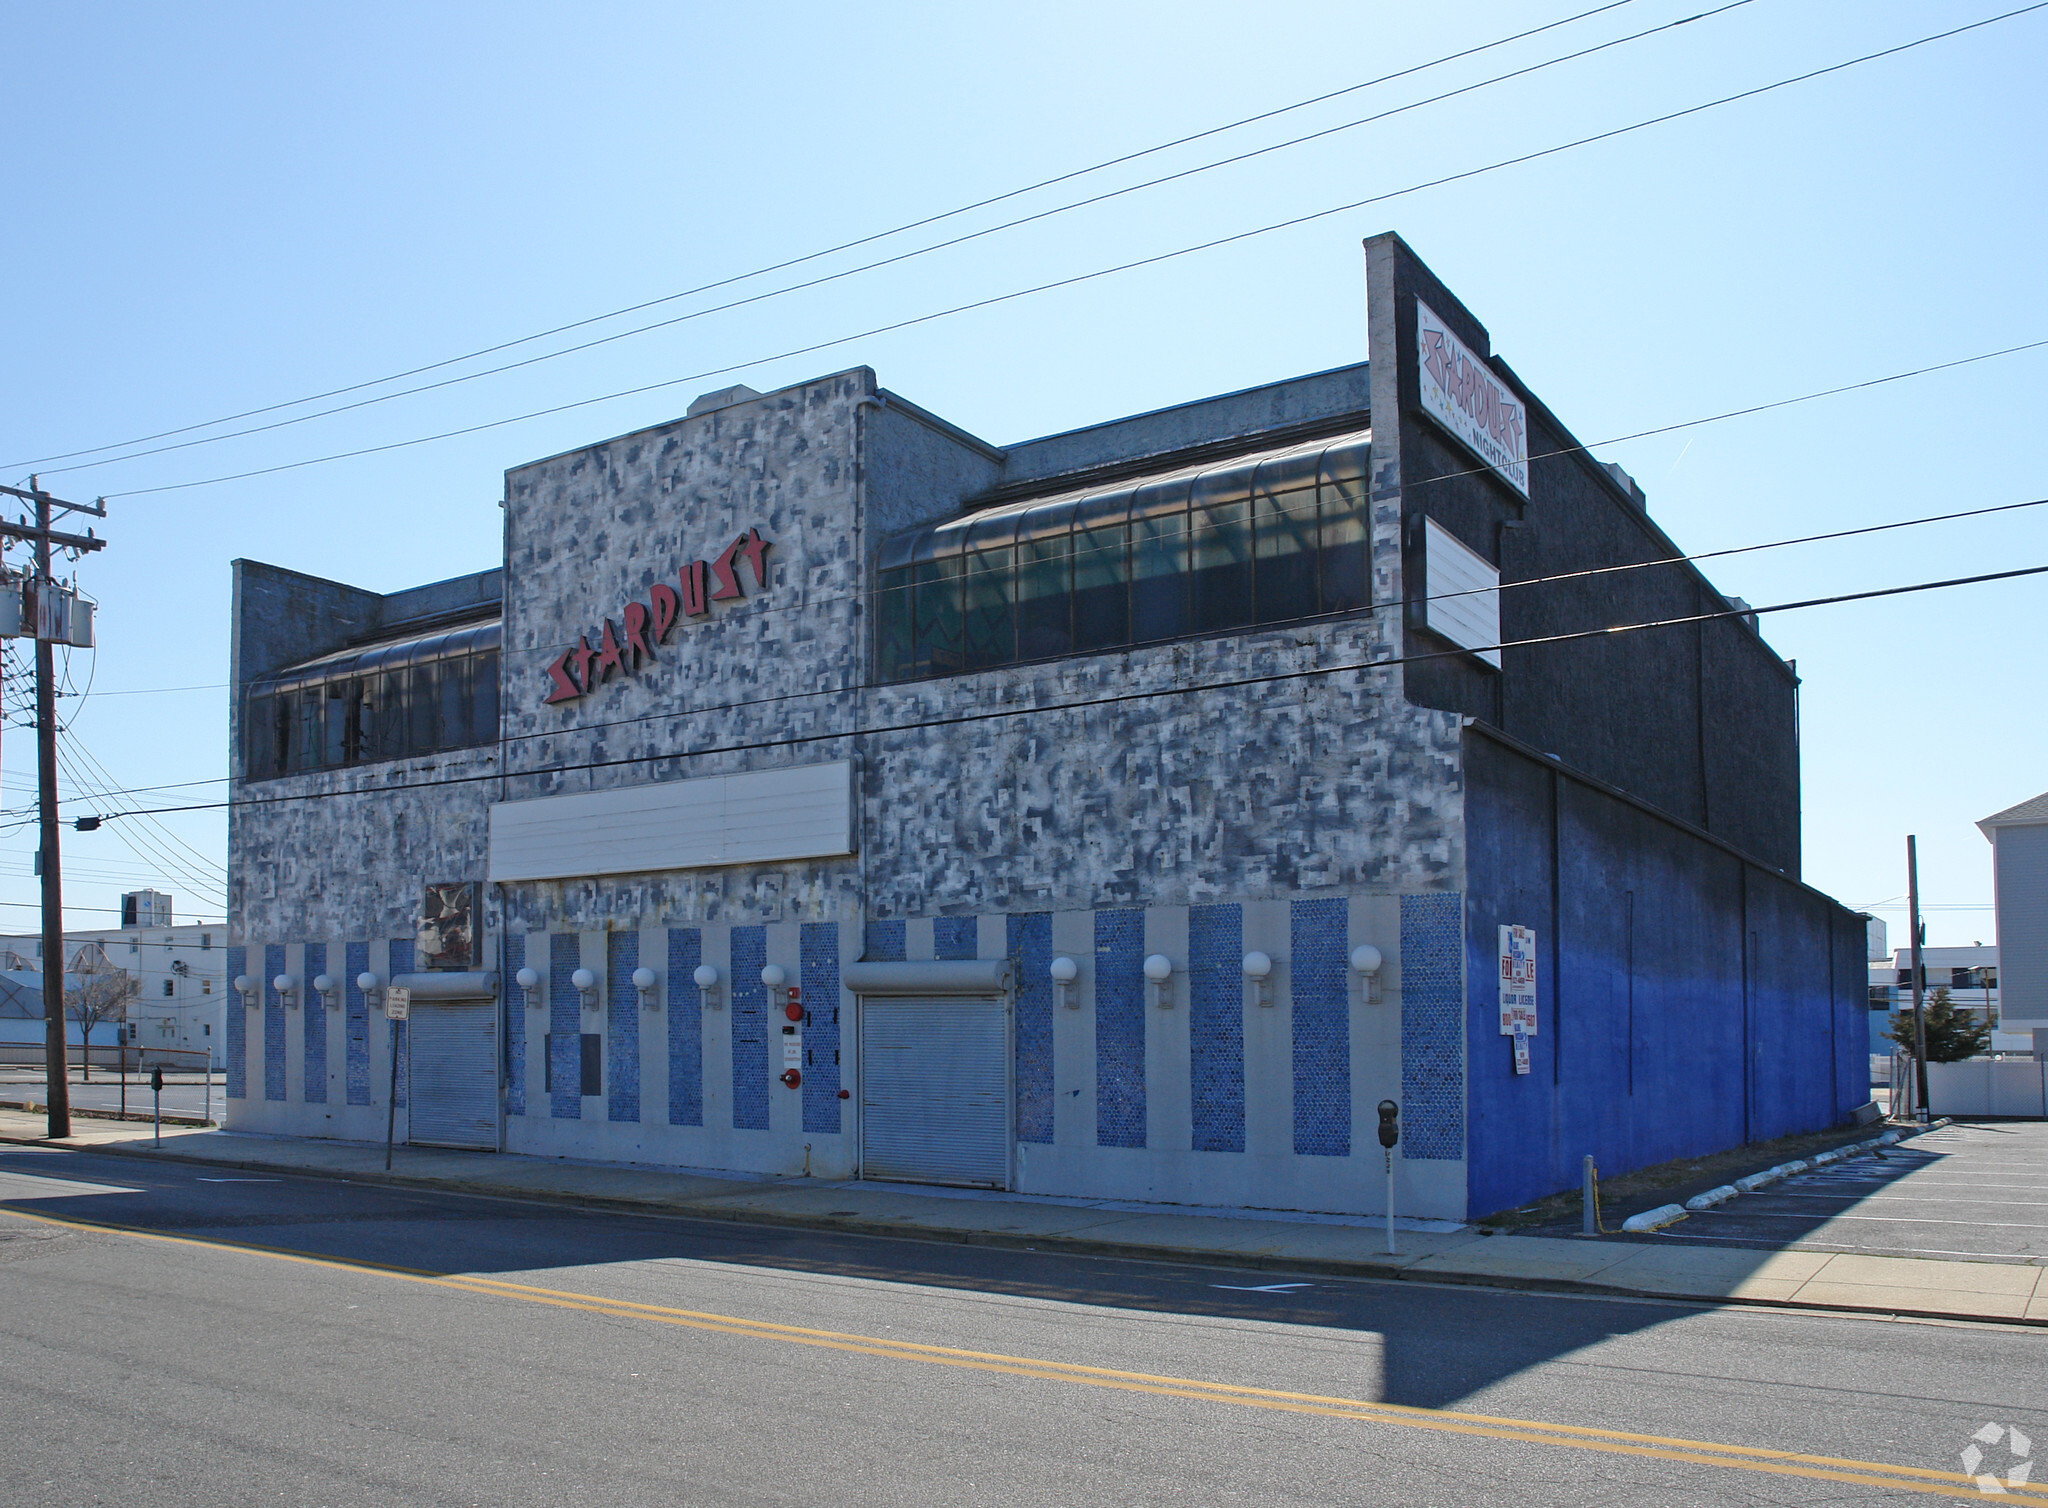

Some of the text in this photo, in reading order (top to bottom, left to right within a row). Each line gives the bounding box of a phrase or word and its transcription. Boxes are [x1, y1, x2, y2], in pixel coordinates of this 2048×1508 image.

[1423, 329, 1523, 461] STARDUST
[1472, 428, 1525, 487] NIGHTCLUB
[543, 527, 771, 703] STARDUST
[1502, 993, 1534, 1006] LIQUOR LICENSE
